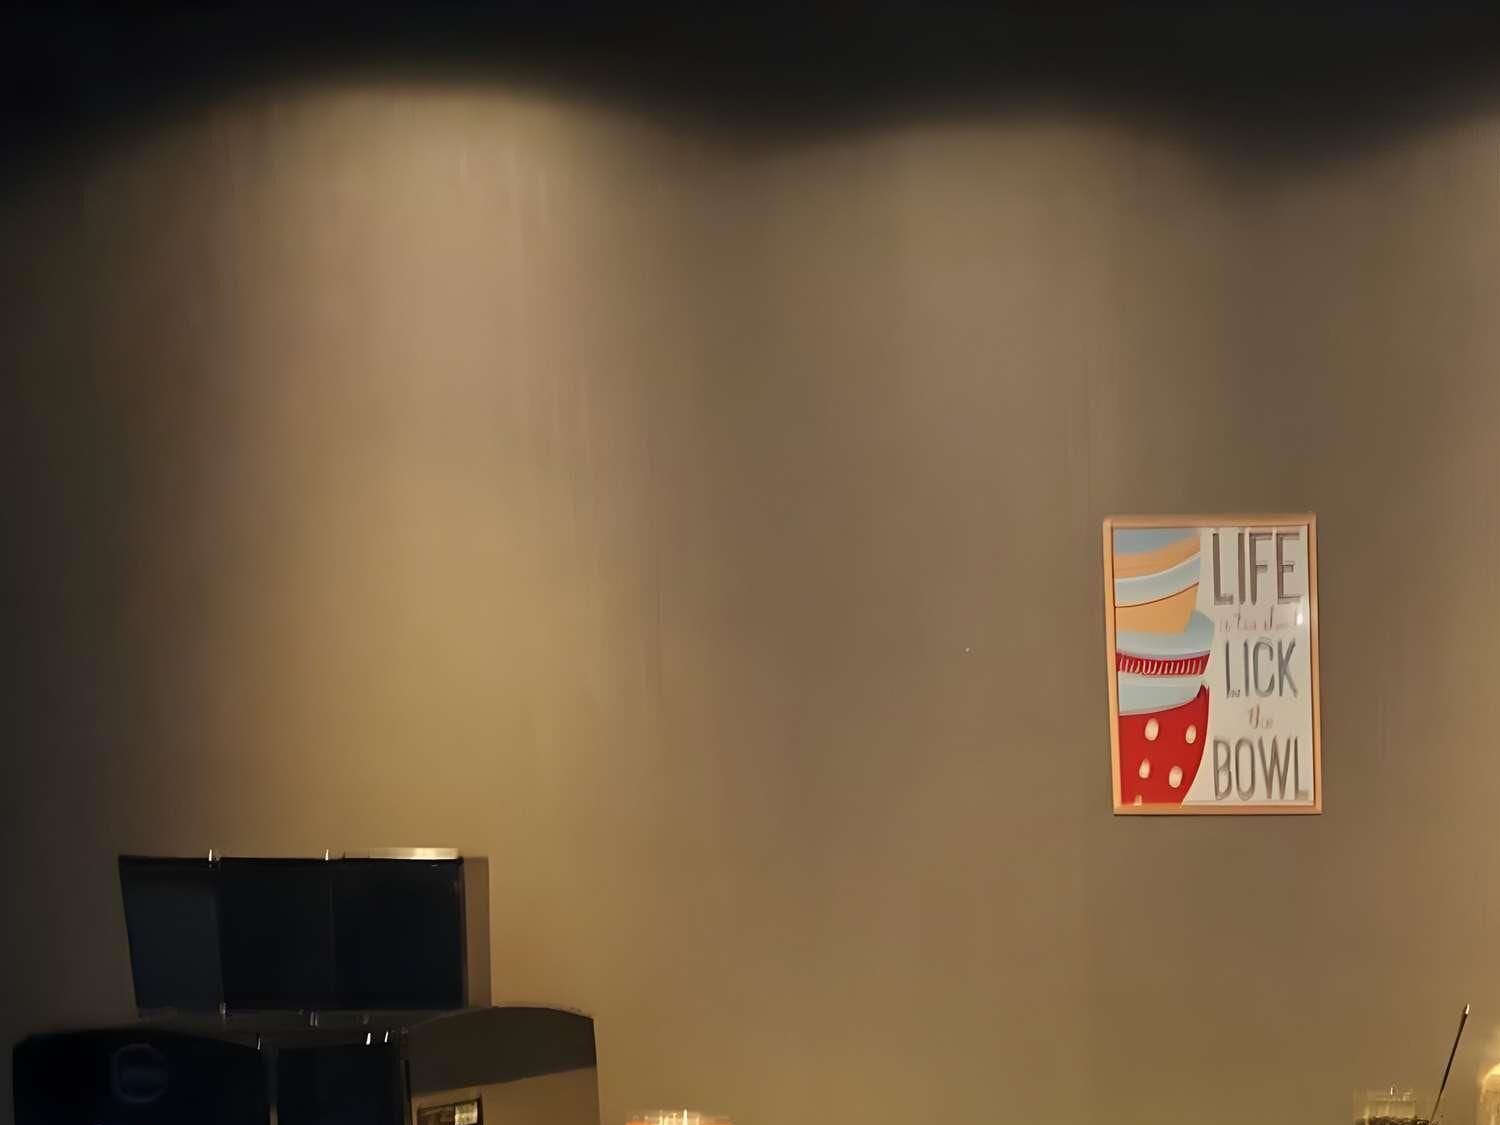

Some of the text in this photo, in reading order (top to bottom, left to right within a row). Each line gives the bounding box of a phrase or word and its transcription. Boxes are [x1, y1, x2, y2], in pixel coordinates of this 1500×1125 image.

[1211, 532, 1301, 605] LIFE
[1225, 638, 1299, 698] LICK
[1213, 735, 1309, 801] BOWL
